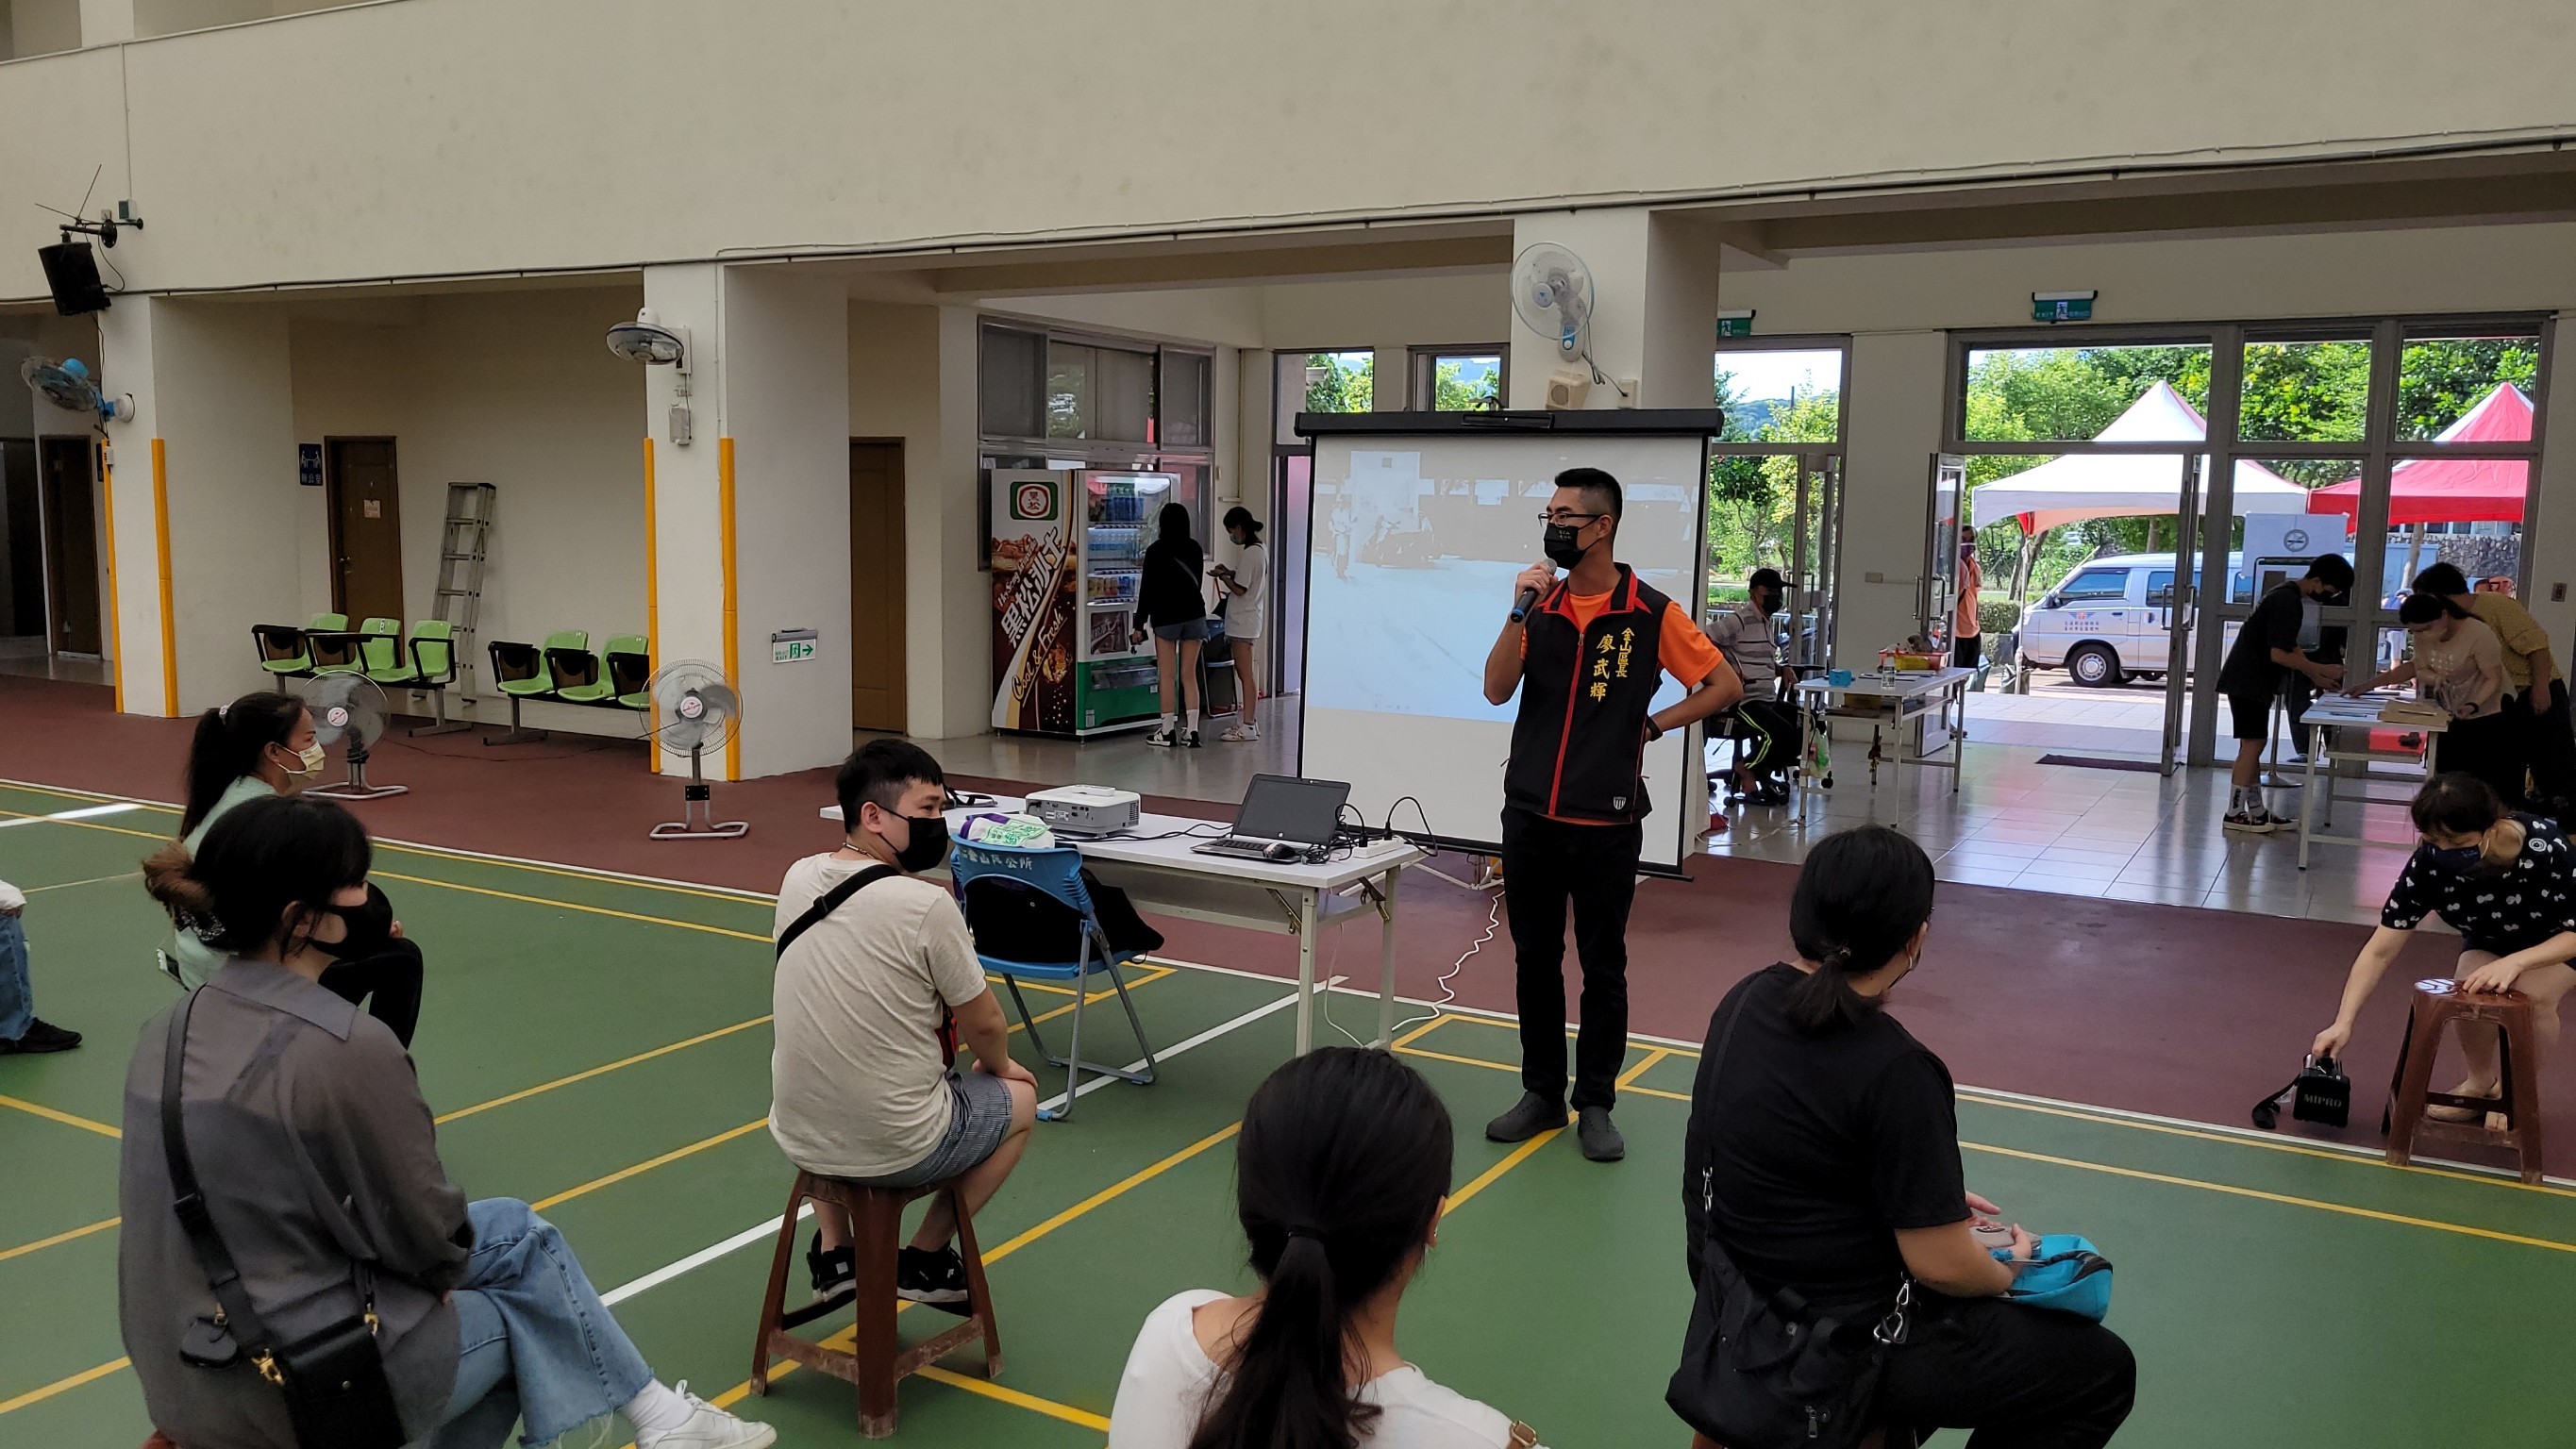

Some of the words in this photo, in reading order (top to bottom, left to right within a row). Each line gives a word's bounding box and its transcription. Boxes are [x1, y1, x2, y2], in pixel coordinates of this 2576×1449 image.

[1000, 526, 1066, 649] 黑松沙士
[1012, 661, 1035, 700] Cool
[1038, 608, 1063, 653] Fresh
[1589, 633, 1616, 703] 廖武輝
[1614, 626, 1635, 678] 金山區長
[2303, 1093, 2342, 1108] MIPRO
